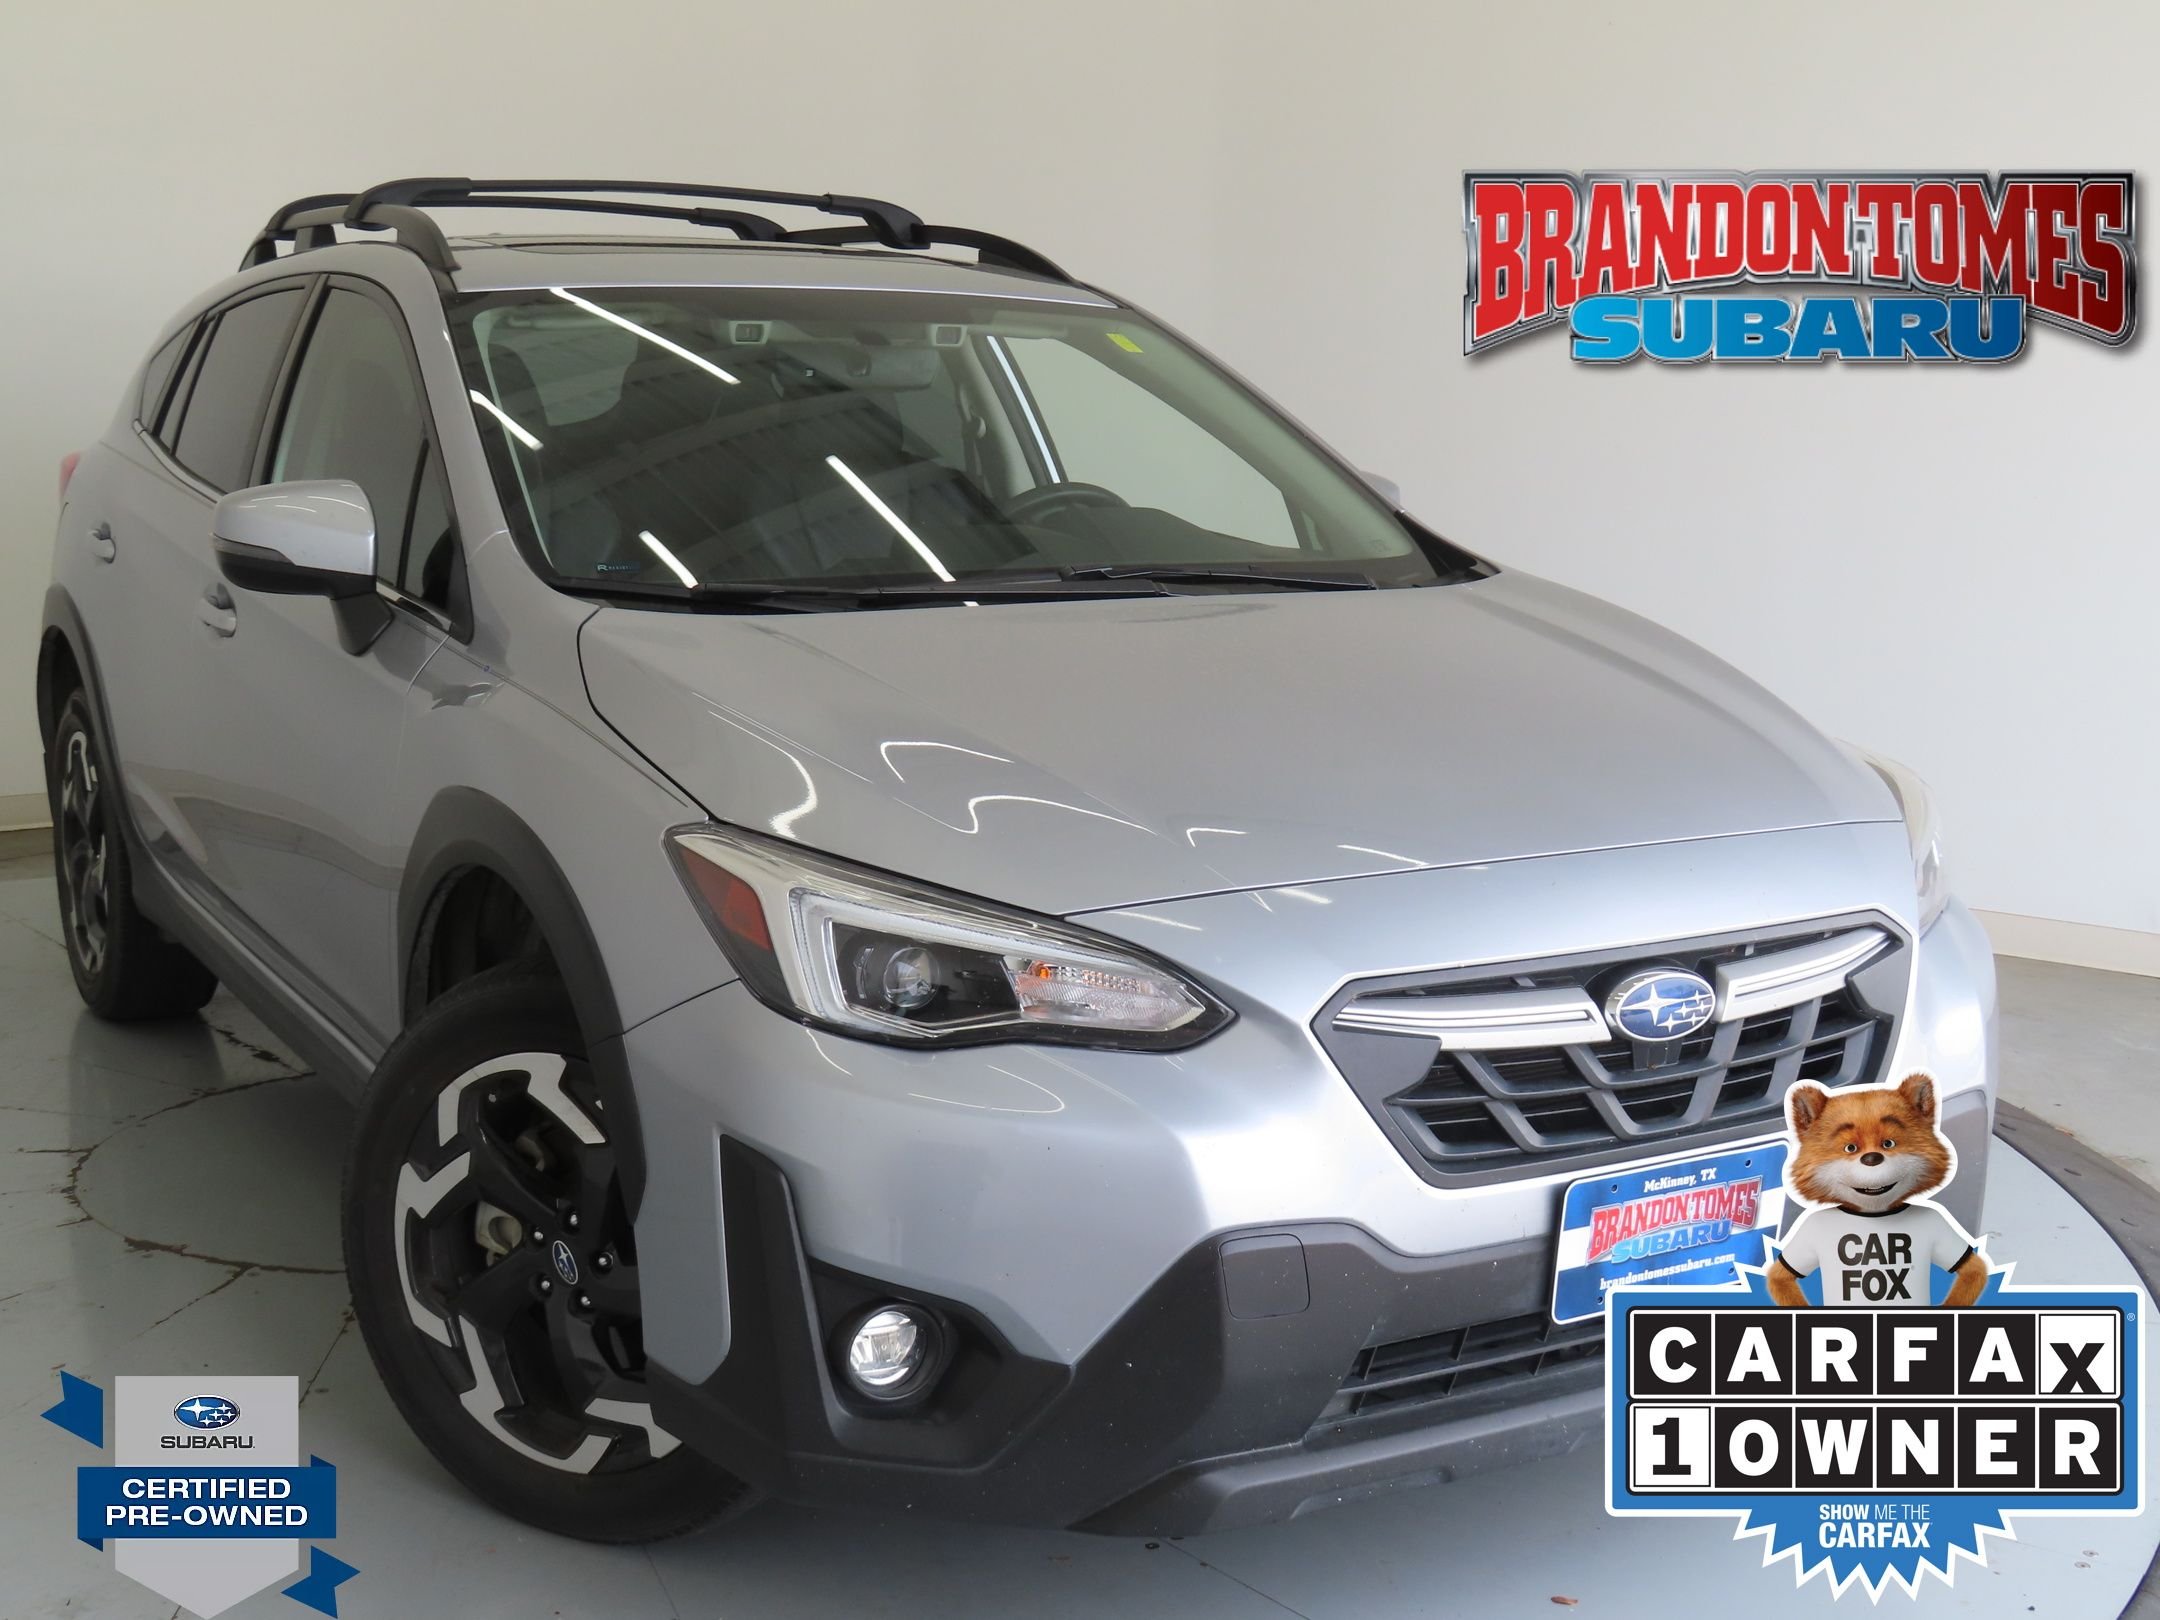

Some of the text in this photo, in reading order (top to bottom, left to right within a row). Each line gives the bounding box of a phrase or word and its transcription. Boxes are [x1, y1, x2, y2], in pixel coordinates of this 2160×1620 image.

[1643, 1168, 1717, 1193] McKinney, TX
[1588, 1180, 1761, 1261] BRANDON TOMES
[1611, 1220, 1733, 1264] SUBARU
[1600, 1253, 1736, 1291] brandontomessubaru.com
